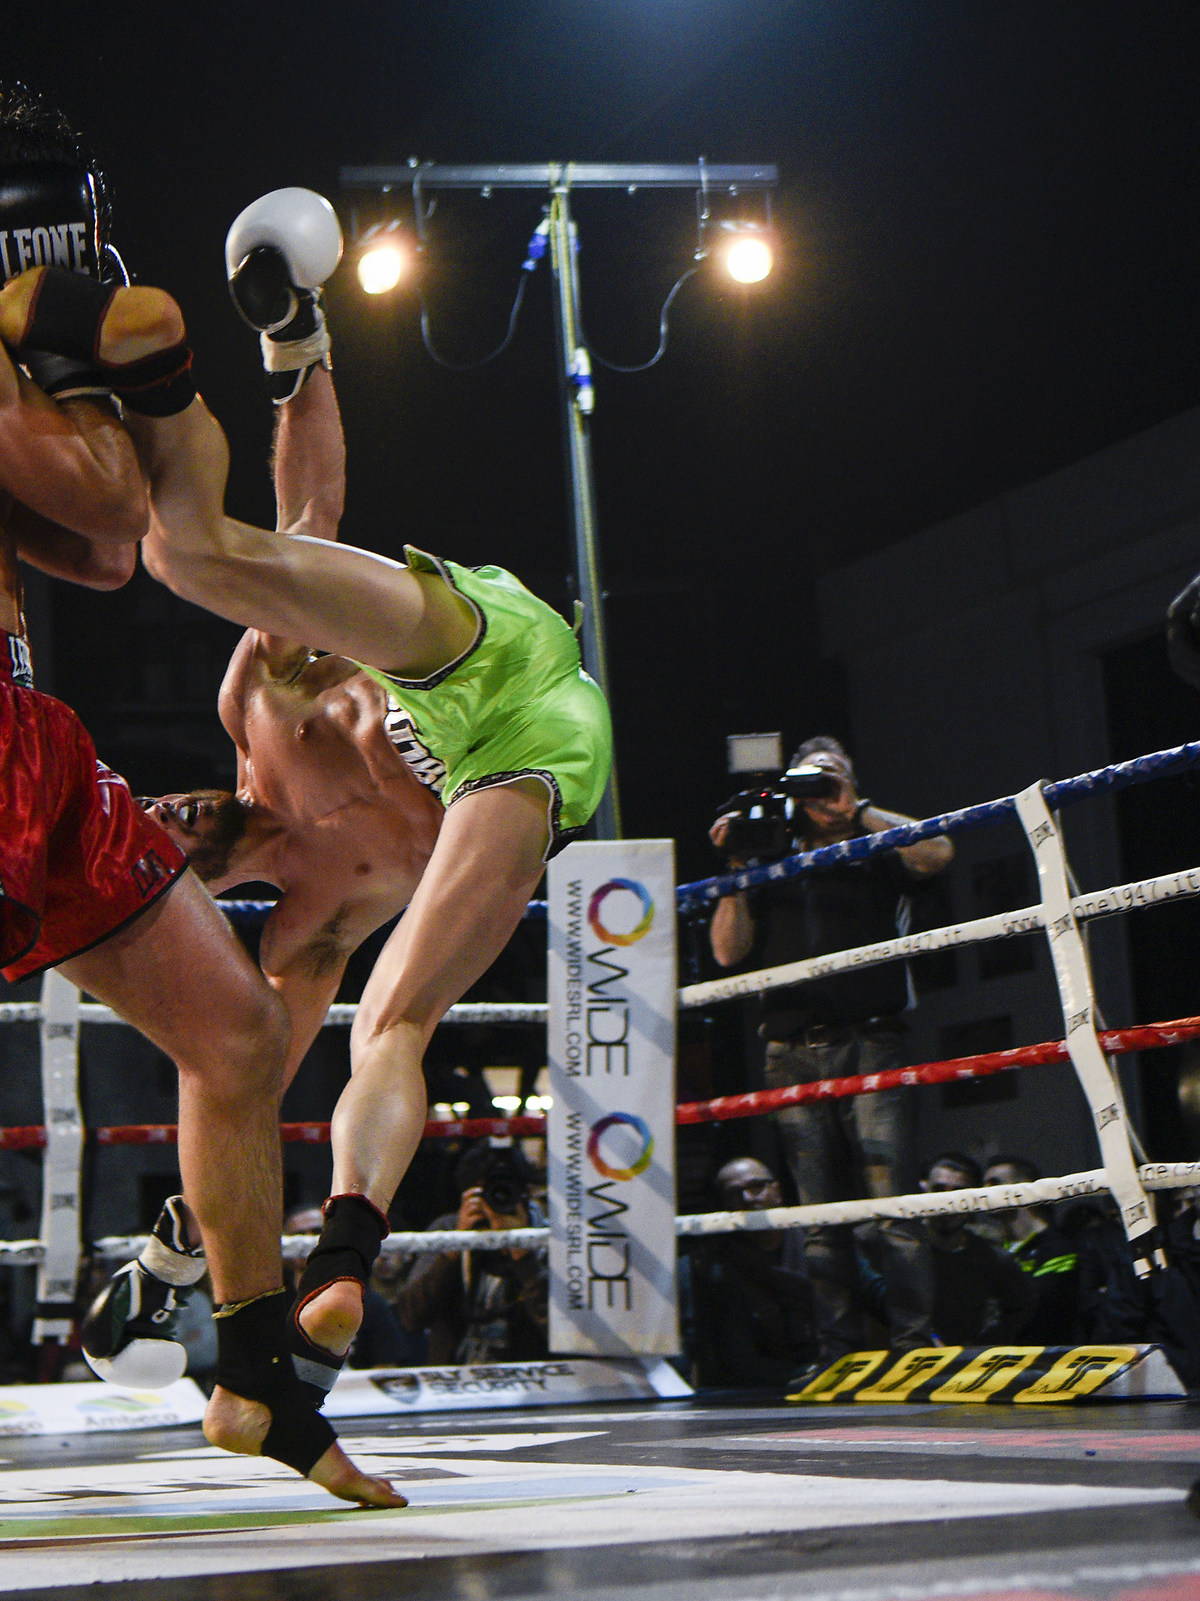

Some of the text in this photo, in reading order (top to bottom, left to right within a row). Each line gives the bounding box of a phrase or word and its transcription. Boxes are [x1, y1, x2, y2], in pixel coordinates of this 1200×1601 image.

[566, 880, 583, 1077] WWW.WIDESRL.COM
[566, 1112, 583, 1311] WWW.WIDESRL.COM
[470, 1364, 574, 1380] SERVICE
[428, 1378, 546, 1395] SECURITY
[85, 1411, 179, 1429] Ambeco
